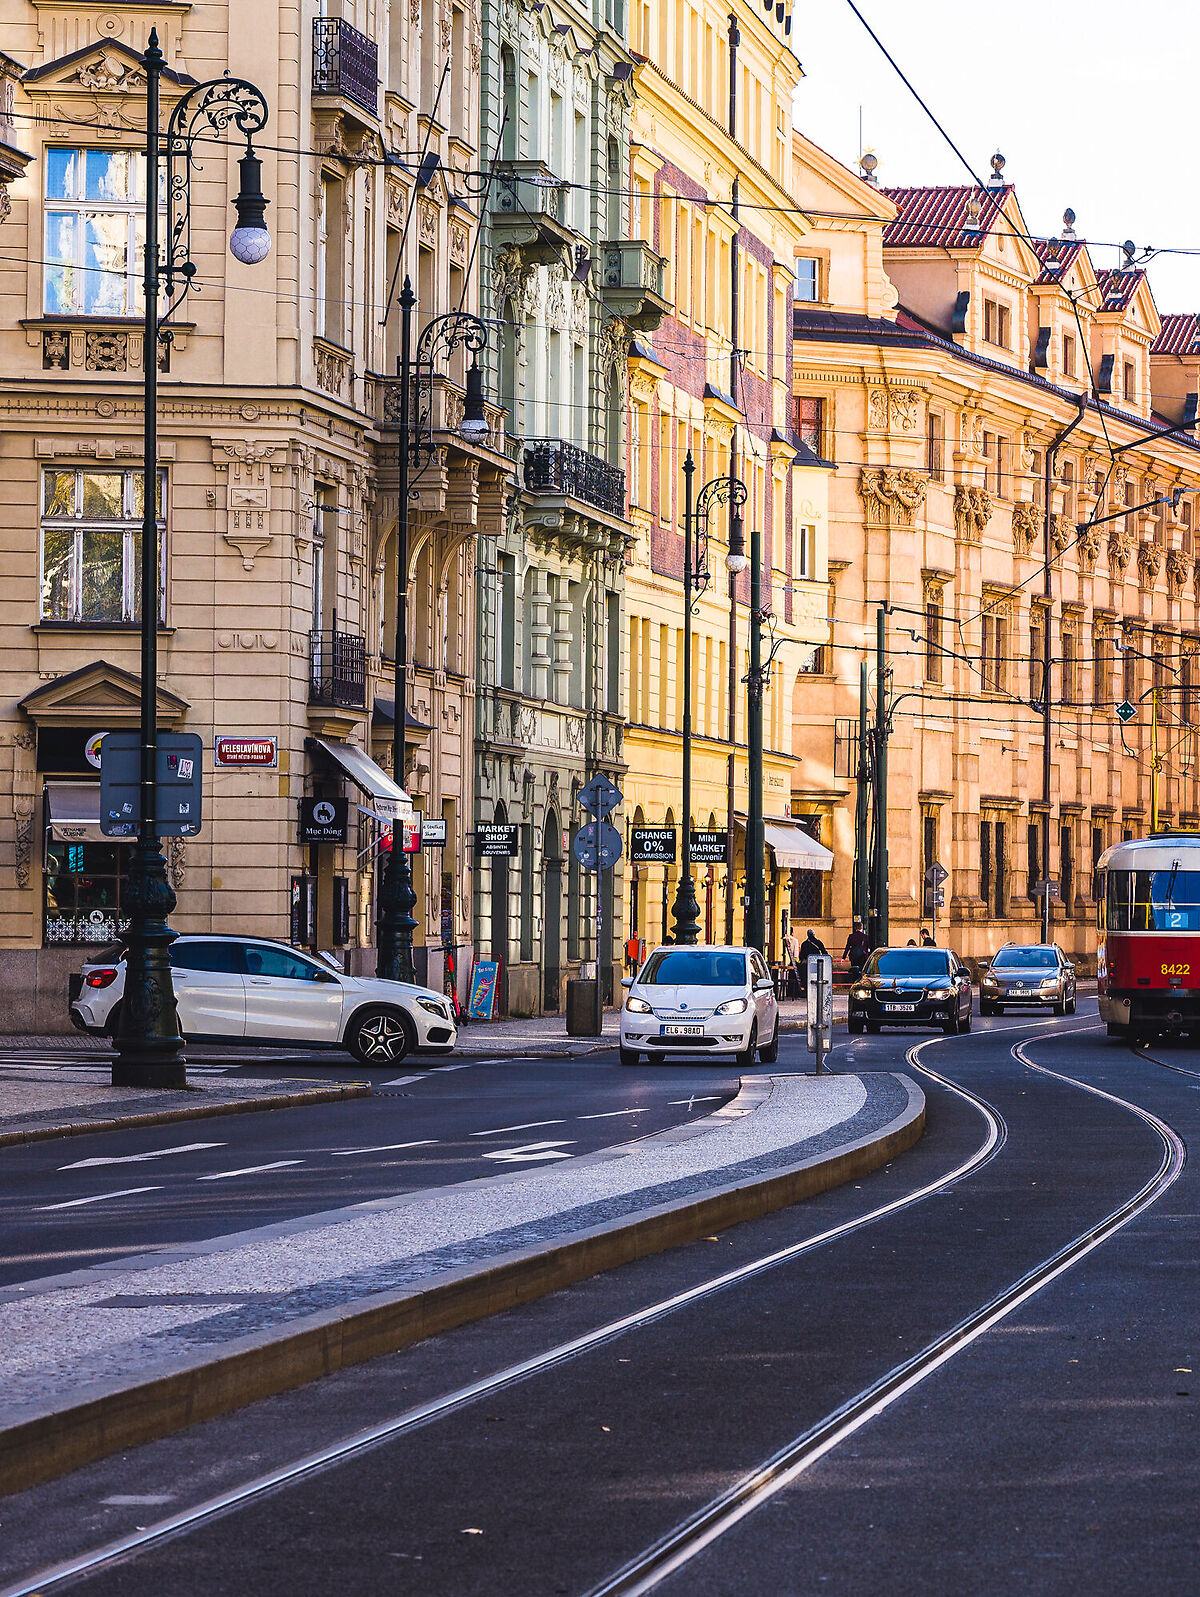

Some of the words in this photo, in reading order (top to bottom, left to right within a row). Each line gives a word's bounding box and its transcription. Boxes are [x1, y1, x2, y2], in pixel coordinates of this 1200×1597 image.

[221, 743, 271, 753] VELESLAVÍNOVA
[477, 825, 515, 833] MARKET
[634, 831, 673, 840] CHANGE
[643, 841, 664, 852] 0%
[690, 844, 725, 852] MARKET
[1170, 913, 1182, 928] 2
[1161, 964, 1190, 975] 8422
